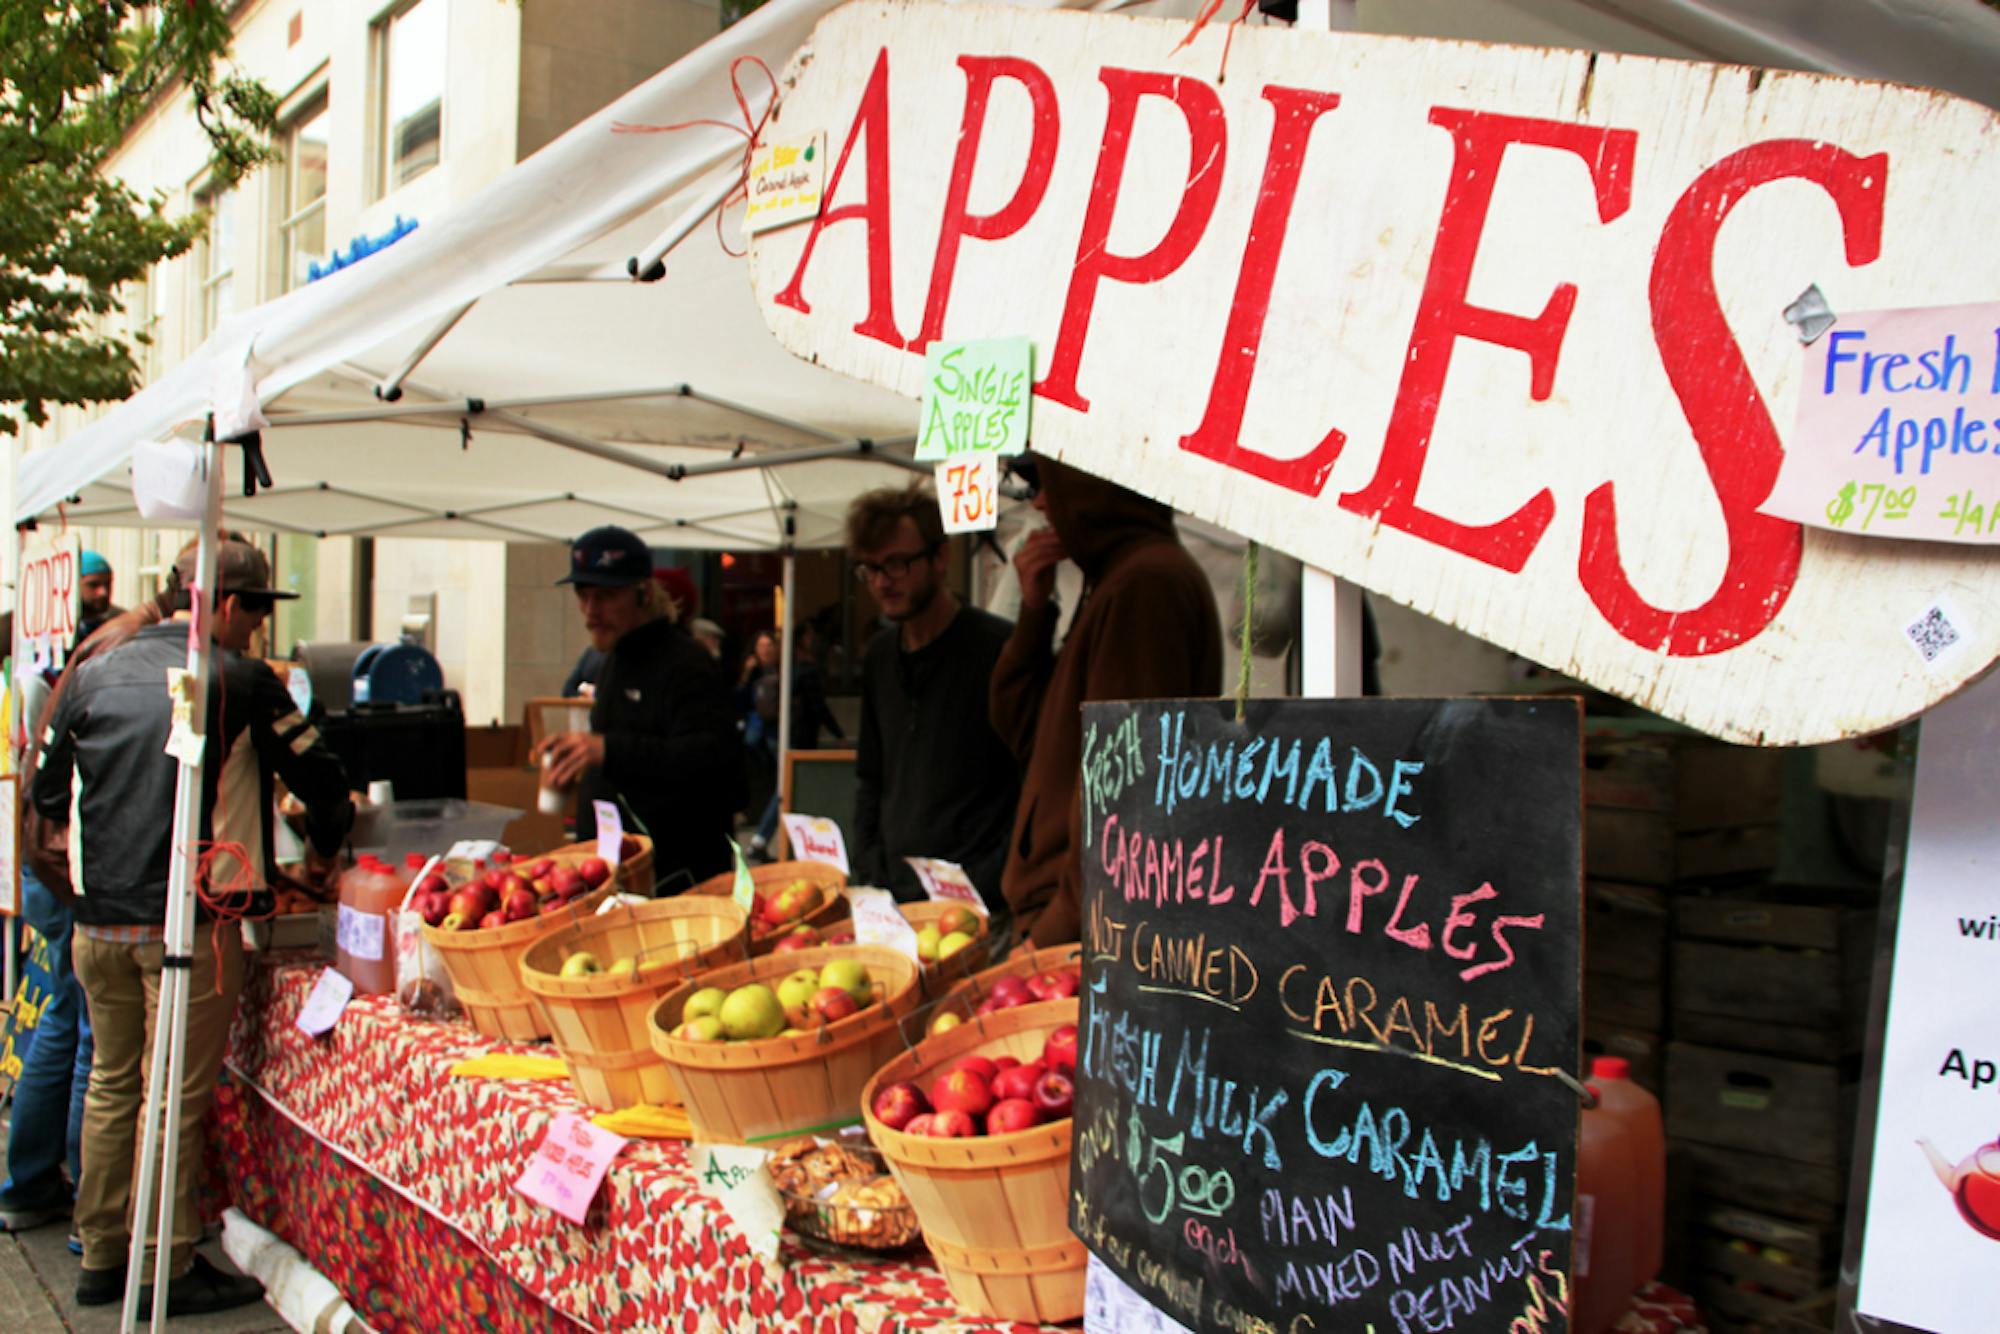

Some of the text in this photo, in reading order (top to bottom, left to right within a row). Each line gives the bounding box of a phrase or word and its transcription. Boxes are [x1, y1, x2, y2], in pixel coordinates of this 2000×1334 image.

[775, 46, 1889, 656] APPLES
[934, 347, 1025, 406] SINGLE
[1824, 331, 1971, 394] Fresh
[920, 393, 1016, 454] APPLES
[23, 551, 73, 639] CIDER
[1082, 711, 1426, 848] FRESH HOMEMADE
[1102, 813, 1546, 982] CARAMEL APPLES
[1958, 915, 2000, 940] wi
[1090, 890, 1560, 1076] NOT CANNED CARAMEL
[1939, 1048, 2000, 1090] Ap
[1167, 1026, 1289, 1171] MILK
[1303, 1068, 1572, 1230] CARAMEL
[1276, 1214, 1473, 1307] MIXED NUT
[1389, 1231, 1538, 1334] PEANUT
